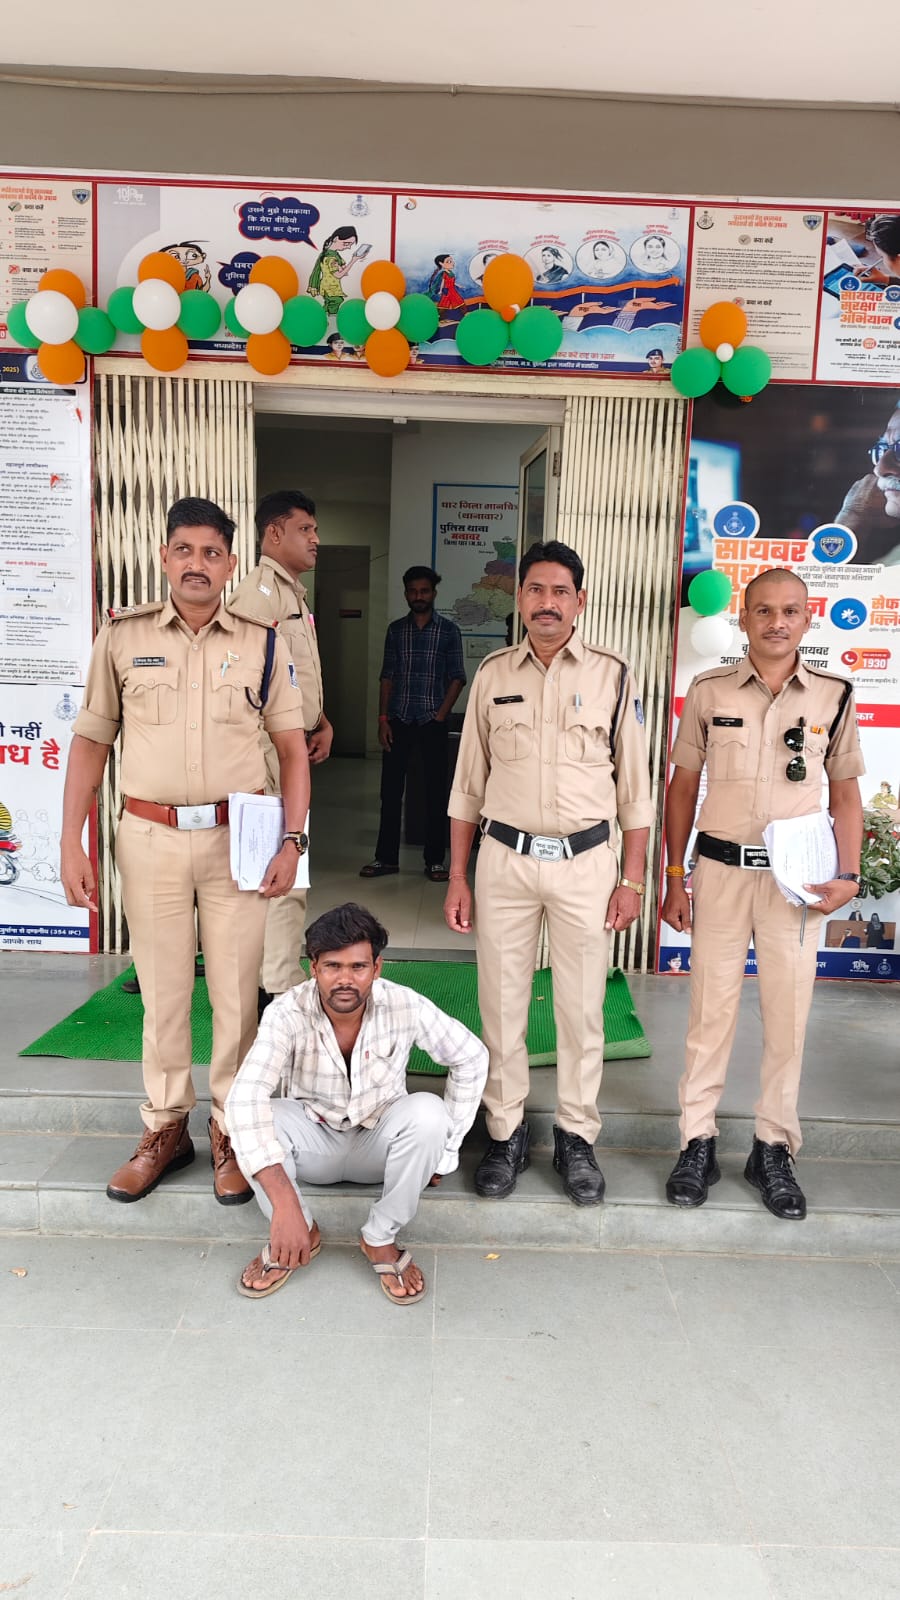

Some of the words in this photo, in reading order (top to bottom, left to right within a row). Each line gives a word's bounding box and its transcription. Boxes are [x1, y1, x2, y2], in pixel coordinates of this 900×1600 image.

[274, 215, 297, 224] वीडियो
[840, 291, 884, 301] सायबर
[840, 301, 877, 314] सुरक्षा
[840, 312, 893, 325] अभियान
[460, 500, 481, 509] जिला
[440, 521, 465, 534] पुलिस
[467, 524, 489, 533] थाना
[451, 532, 481, 541] मनावर
[714, 539, 809, 562] सायबर
[720, 656, 745, 665] अपरा
[863, 658, 886, 669] 1930
[10, 721, 42, 741] नहीं
[40, 738, 60, 770] है
[2, 937, 24, 945] आपके
